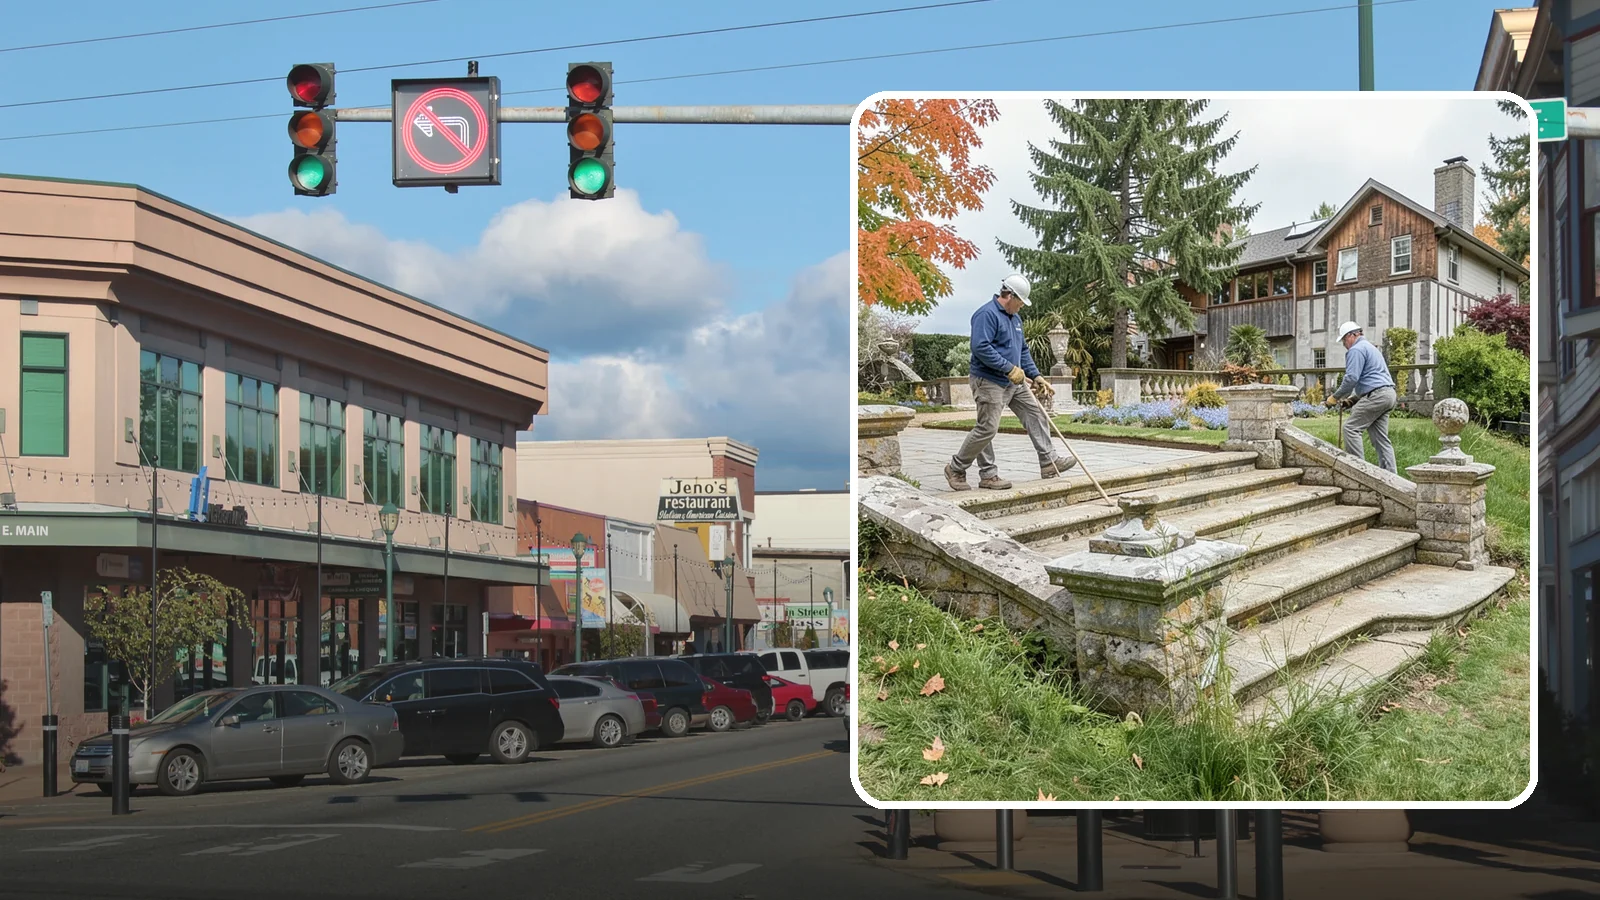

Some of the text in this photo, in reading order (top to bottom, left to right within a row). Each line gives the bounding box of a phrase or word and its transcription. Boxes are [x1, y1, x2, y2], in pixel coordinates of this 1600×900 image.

[669, 480, 728, 495] Jeno's
[665, 496, 731, 509] restaurant
[658, 510, 682, 520] Italian
[685, 510, 715, 520] American
[2, 525, 49, 536] E. MAIN
[797, 607, 828, 617] Street
